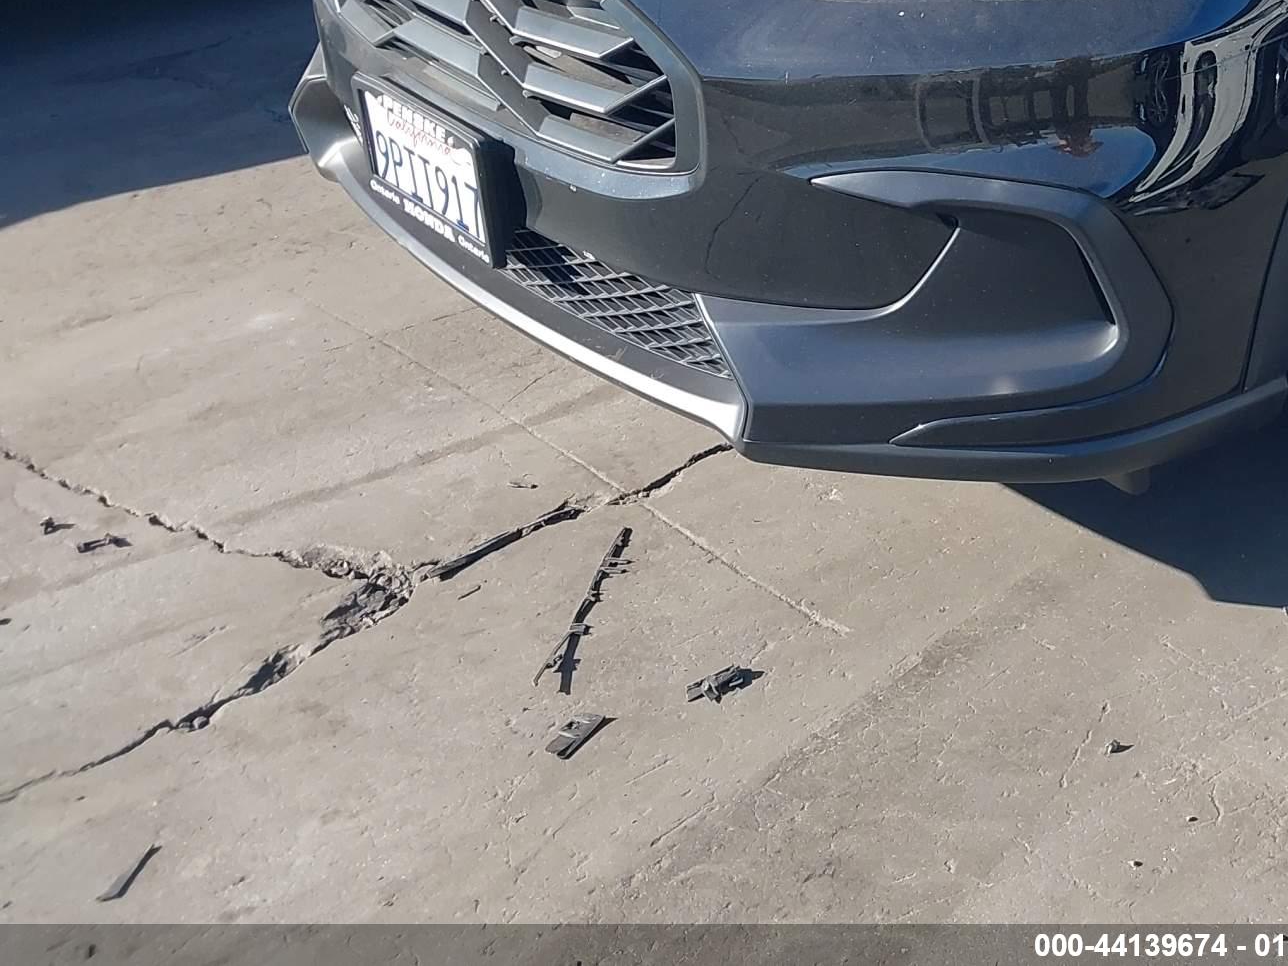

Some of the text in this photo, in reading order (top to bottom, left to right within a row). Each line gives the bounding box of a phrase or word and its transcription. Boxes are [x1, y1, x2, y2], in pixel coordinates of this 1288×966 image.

[383, 95, 446, 144] PENSKE
[370, 179, 490, 264] Ontario HONDA Ontario
